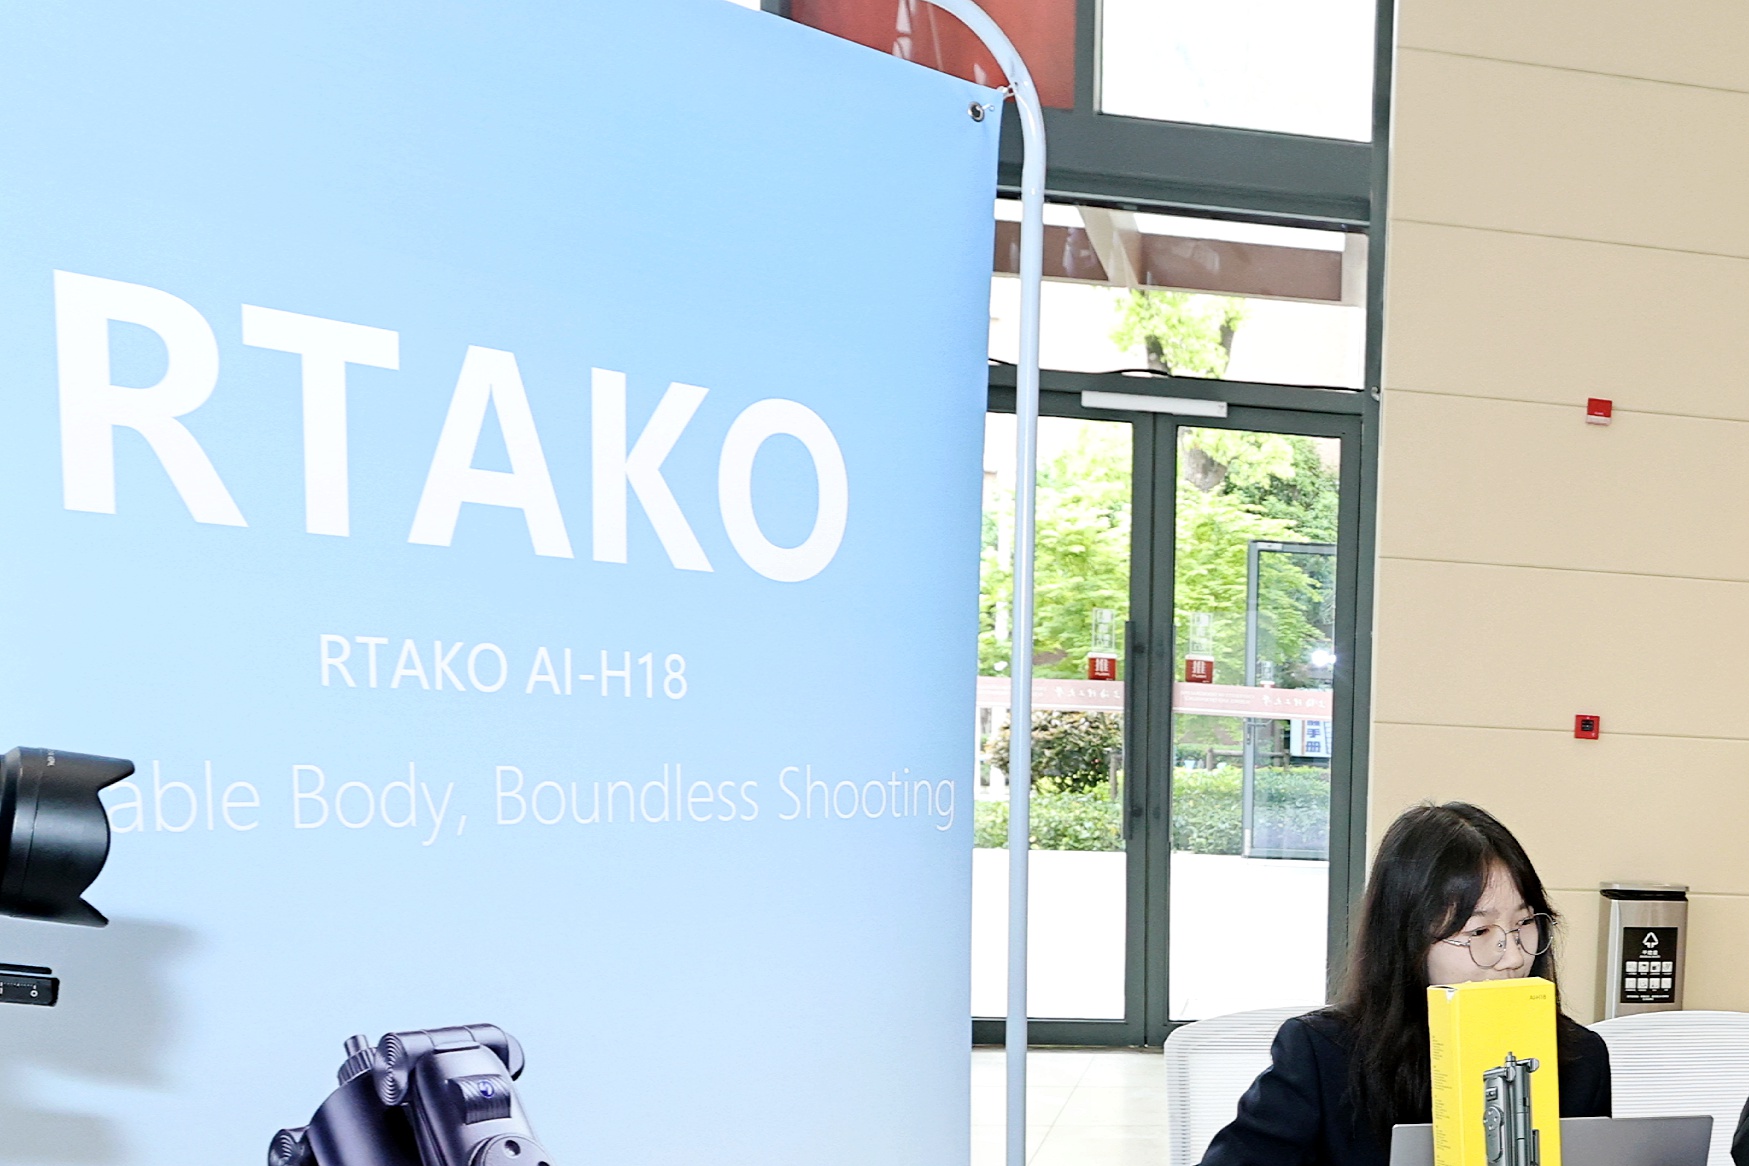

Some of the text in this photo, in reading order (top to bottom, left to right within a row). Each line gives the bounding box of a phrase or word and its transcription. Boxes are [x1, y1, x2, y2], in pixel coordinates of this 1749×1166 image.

[54, 269, 848, 582] RTAKO
[320, 634, 688, 699] RTAKO AI-H18
[107, 759, 955, 847] able Body, Boundless Shooting
